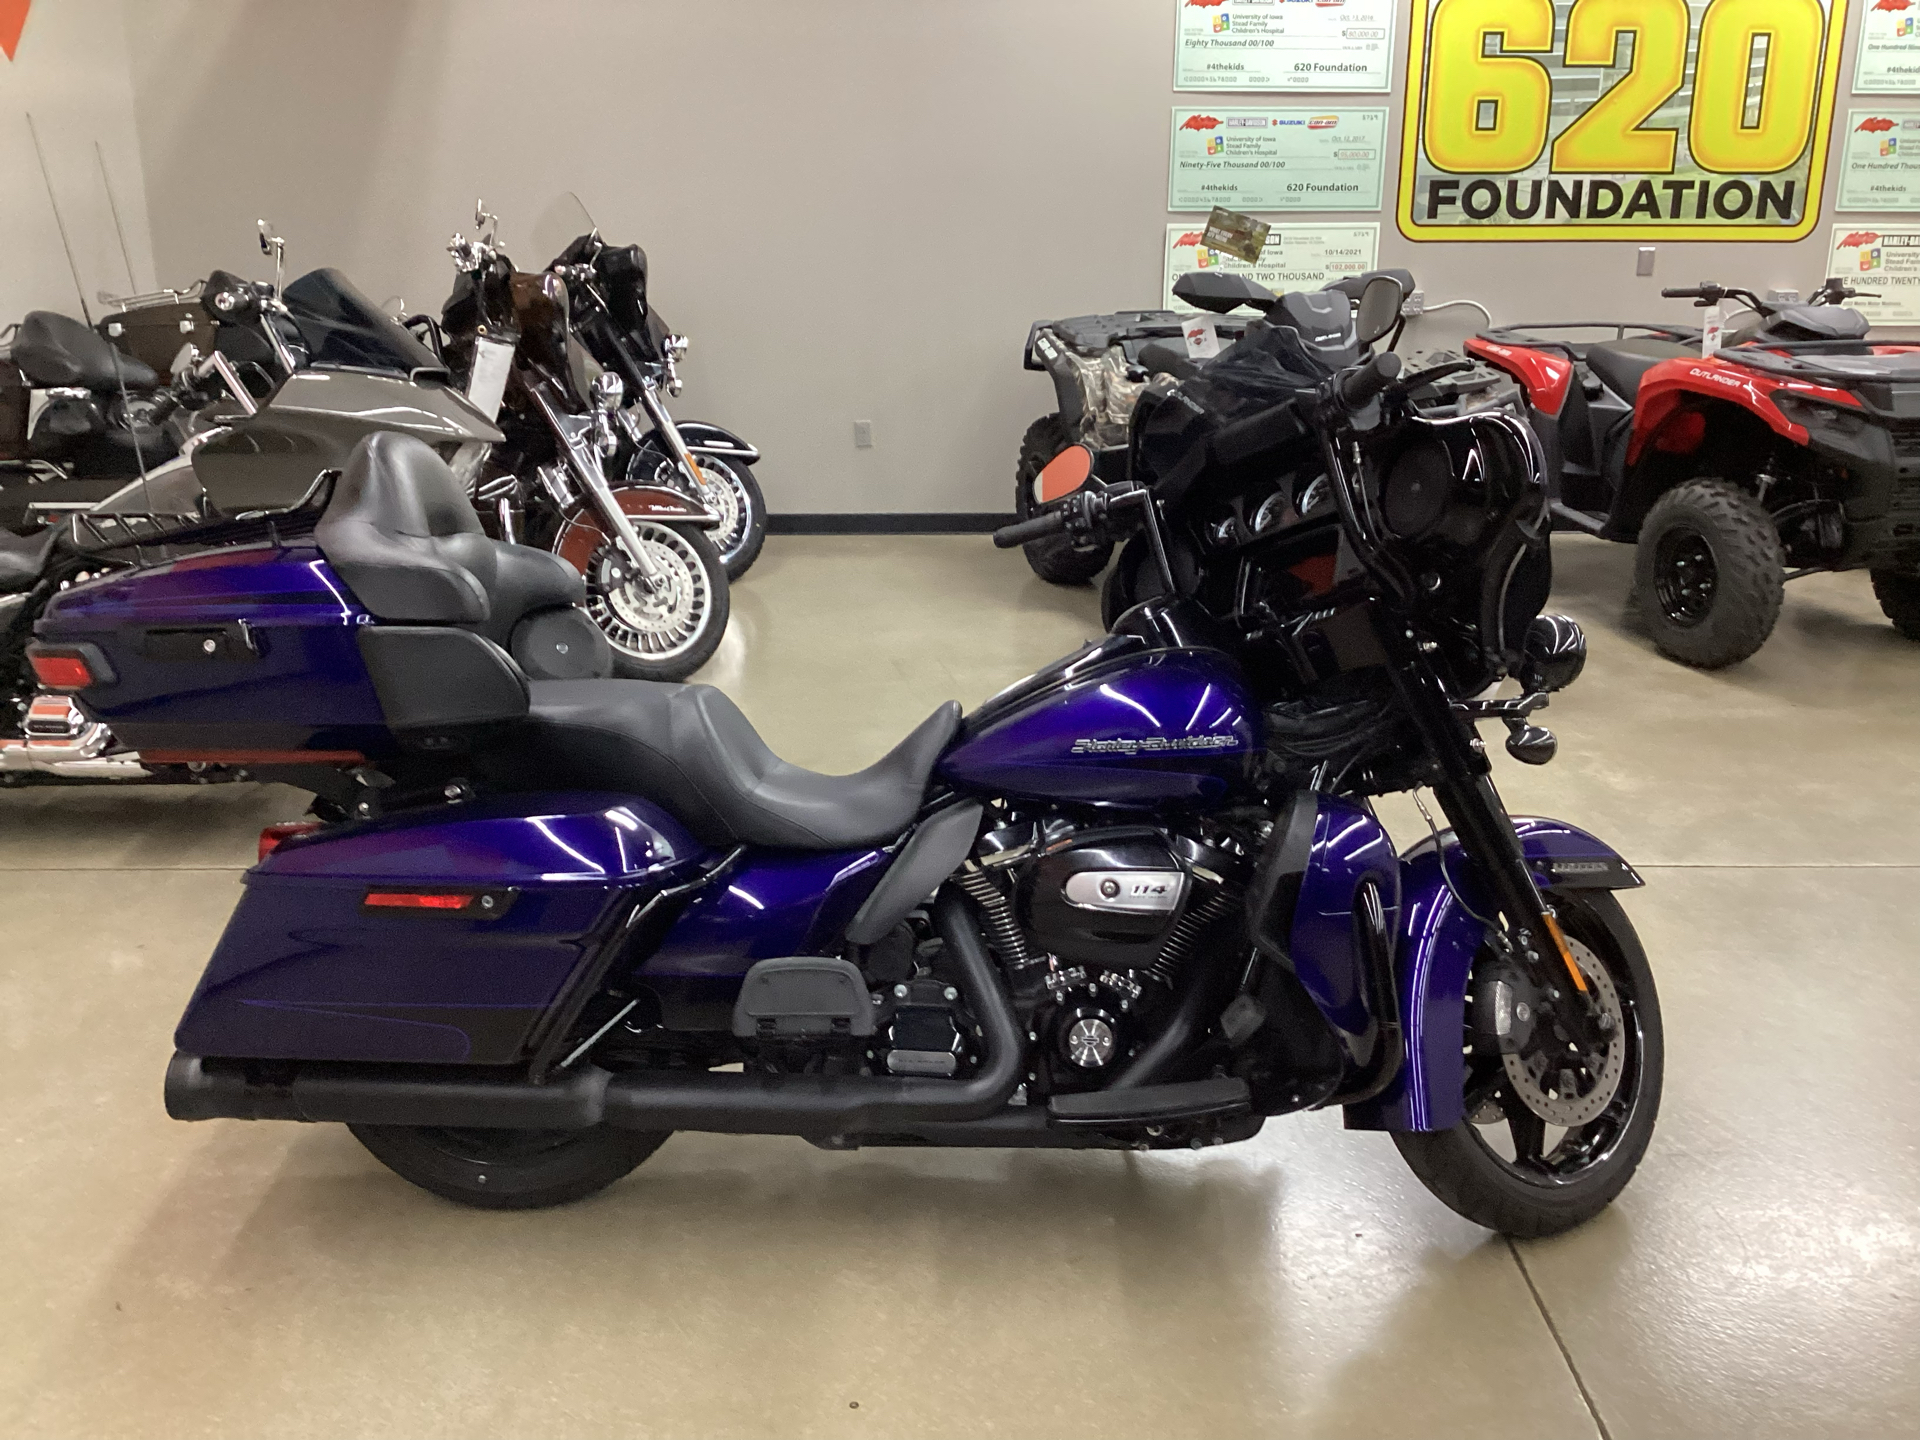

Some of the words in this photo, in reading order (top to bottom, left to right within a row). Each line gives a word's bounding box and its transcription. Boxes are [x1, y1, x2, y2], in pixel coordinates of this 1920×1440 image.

[1232, 13, 1260, 21] University
[1251, 20, 1268, 28] Family
[1261, 27, 1285, 35] Hospital
[1185, 39, 1209, 48] Eighty
[1210, 39, 1247, 47] Thousand
[1248, 39, 1275, 48] 00/100
[1206, 63, 1245, 71] #4thekids
[1294, 63, 1312, 72] 620
[1313, 63, 1368, 72] Foundation
[1422, 0, 1826, 174] 620
[1226, 136, 1254, 144] University
[1244, 143, 1261, 151] Family
[1253, 149, 1278, 157] Hospital
[1179, 160, 1221, 169] Ninety-Five
[1223, 161, 1259, 169] Thousand
[1260, 161, 1285, 169] 00/100
[1851, 162, 1866, 170] One
[1867, 162, 1899, 170] Hundred
[1201, 183, 1238, 191] #4thekids
[1287, 183, 1304, 192] 620
[1305, 183, 1359, 192] Foundation
[1426, 179, 1796, 220] FOUNDATION
[1258, 262, 1286, 270] Hospital
[1256, 272, 1275, 281] TWO
[1277, 272, 1325, 281] THOUSAND
[1850, 276, 1888, 285] HUNDRED
[1690, 367, 1741, 388] OUTLANDER
[1131, 884, 1168, 895] 114
